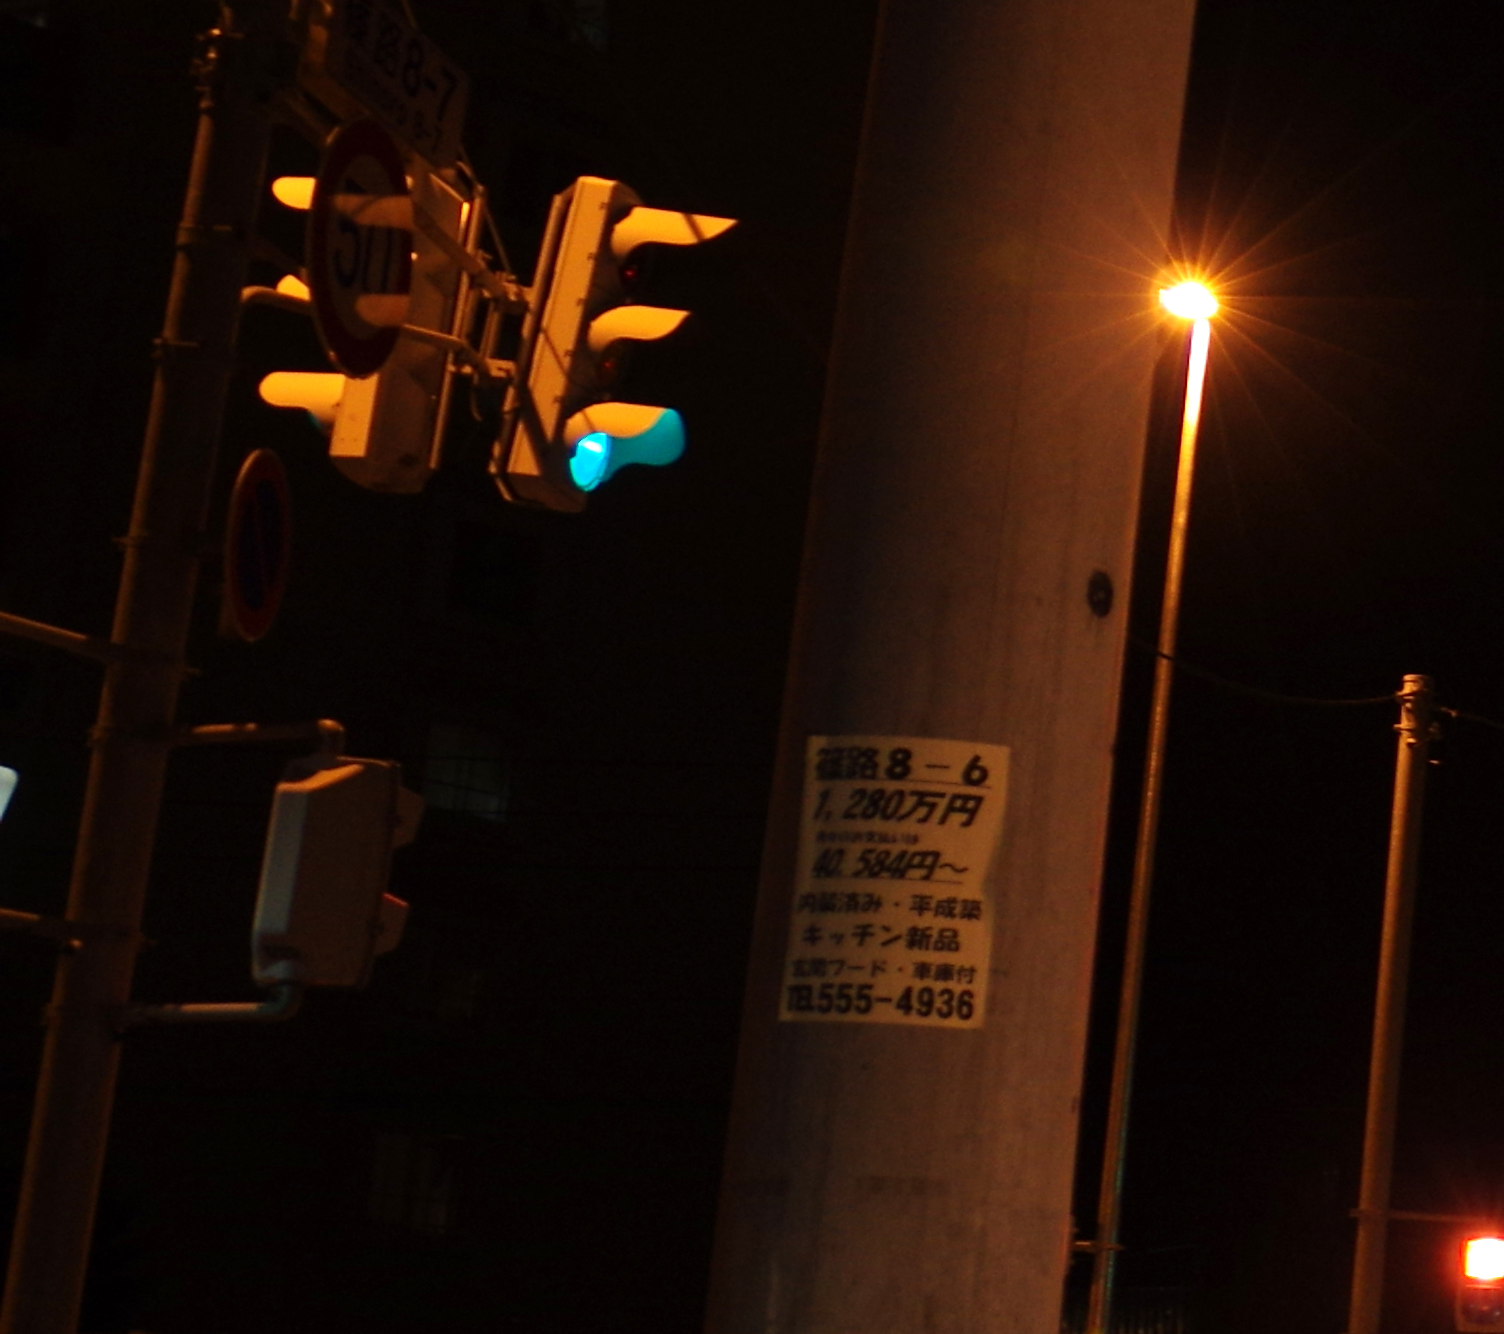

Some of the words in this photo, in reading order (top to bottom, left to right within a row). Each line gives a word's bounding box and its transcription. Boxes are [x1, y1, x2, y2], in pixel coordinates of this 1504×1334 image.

[802, 923, 961, 952] キッチン新品
